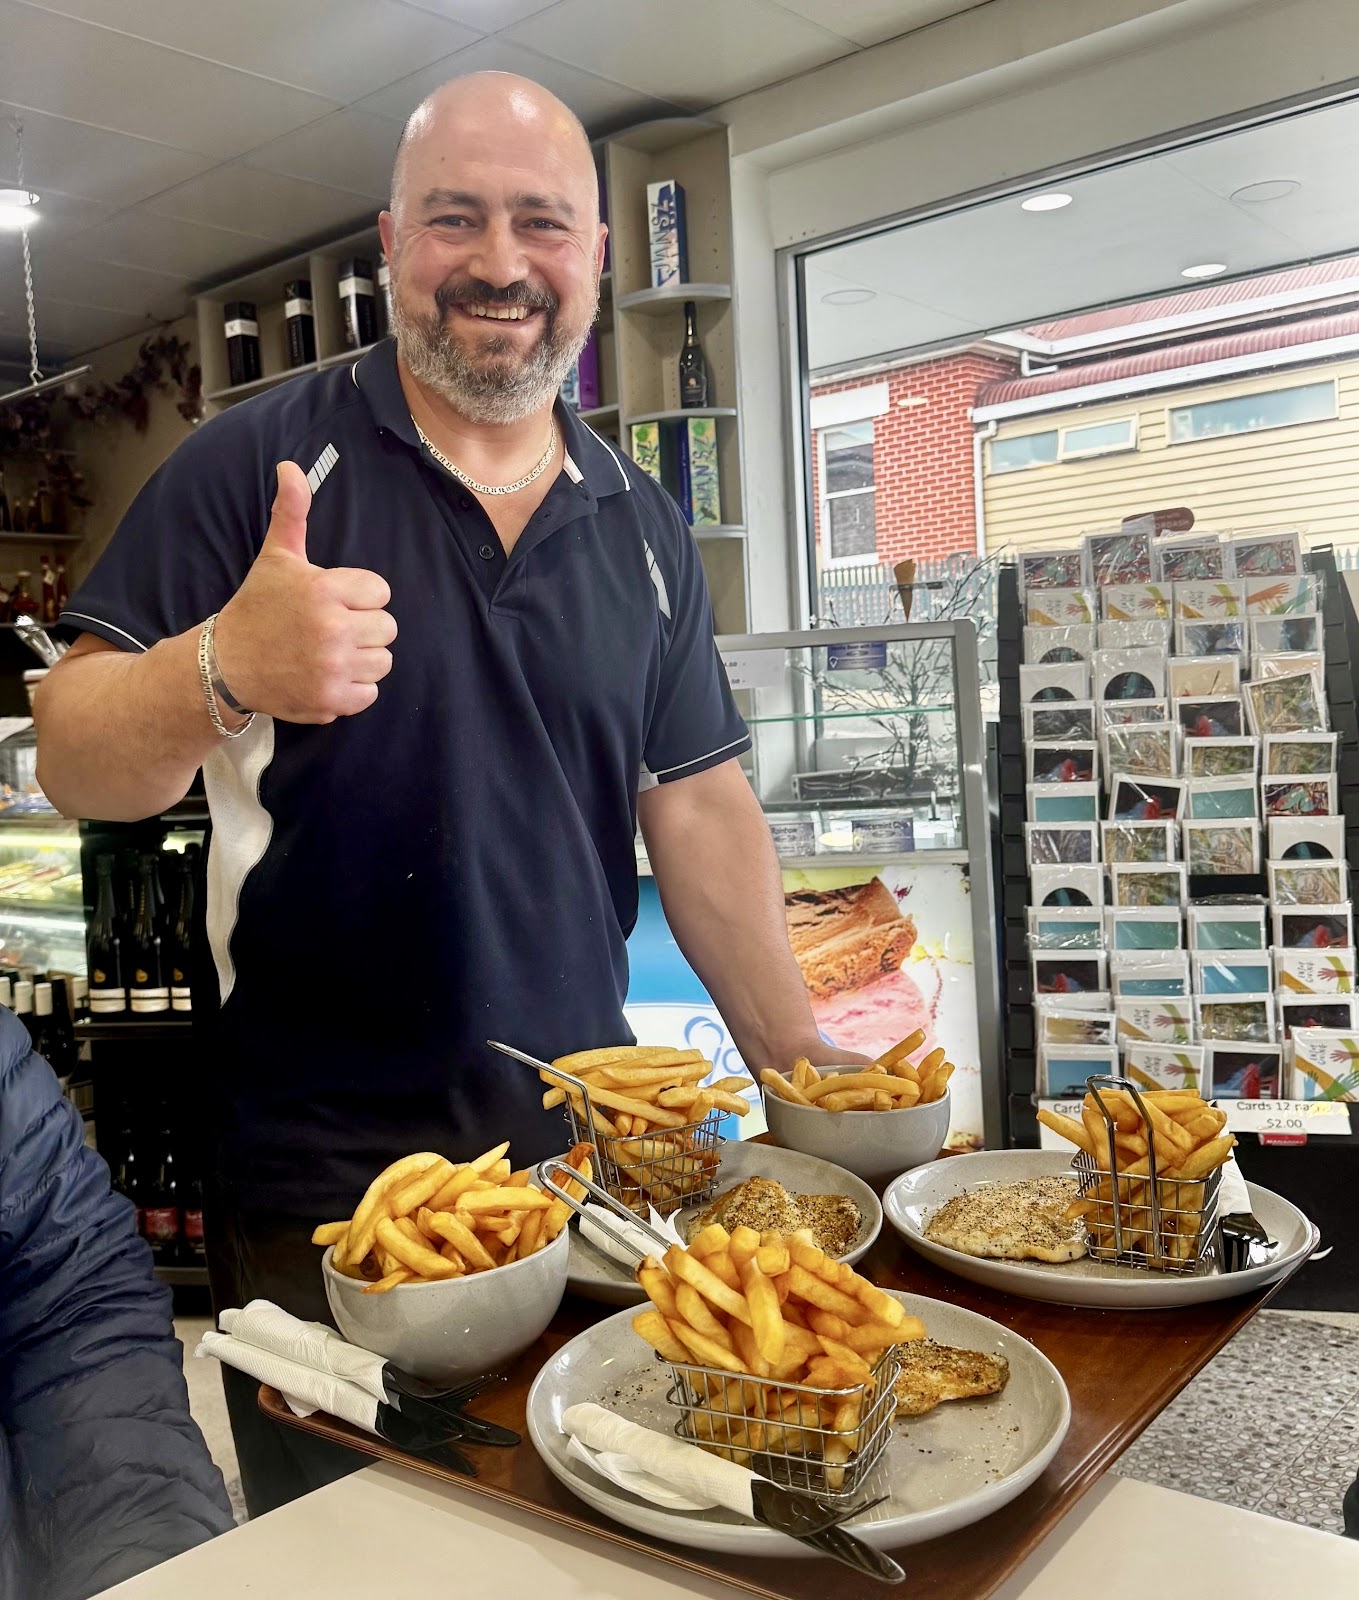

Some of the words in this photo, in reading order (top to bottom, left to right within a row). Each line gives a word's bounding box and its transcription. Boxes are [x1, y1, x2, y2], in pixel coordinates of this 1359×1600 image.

[650, 200, 671, 273] JANSZ
[693, 436, 710, 506] JANSZ
[1053, 1102, 1082, 1113] Card
[1236, 1101, 1272, 1111] Cards
[1277, 1101, 1290, 1111] 12
[1266, 1118, 1303, 1129] $2.00
